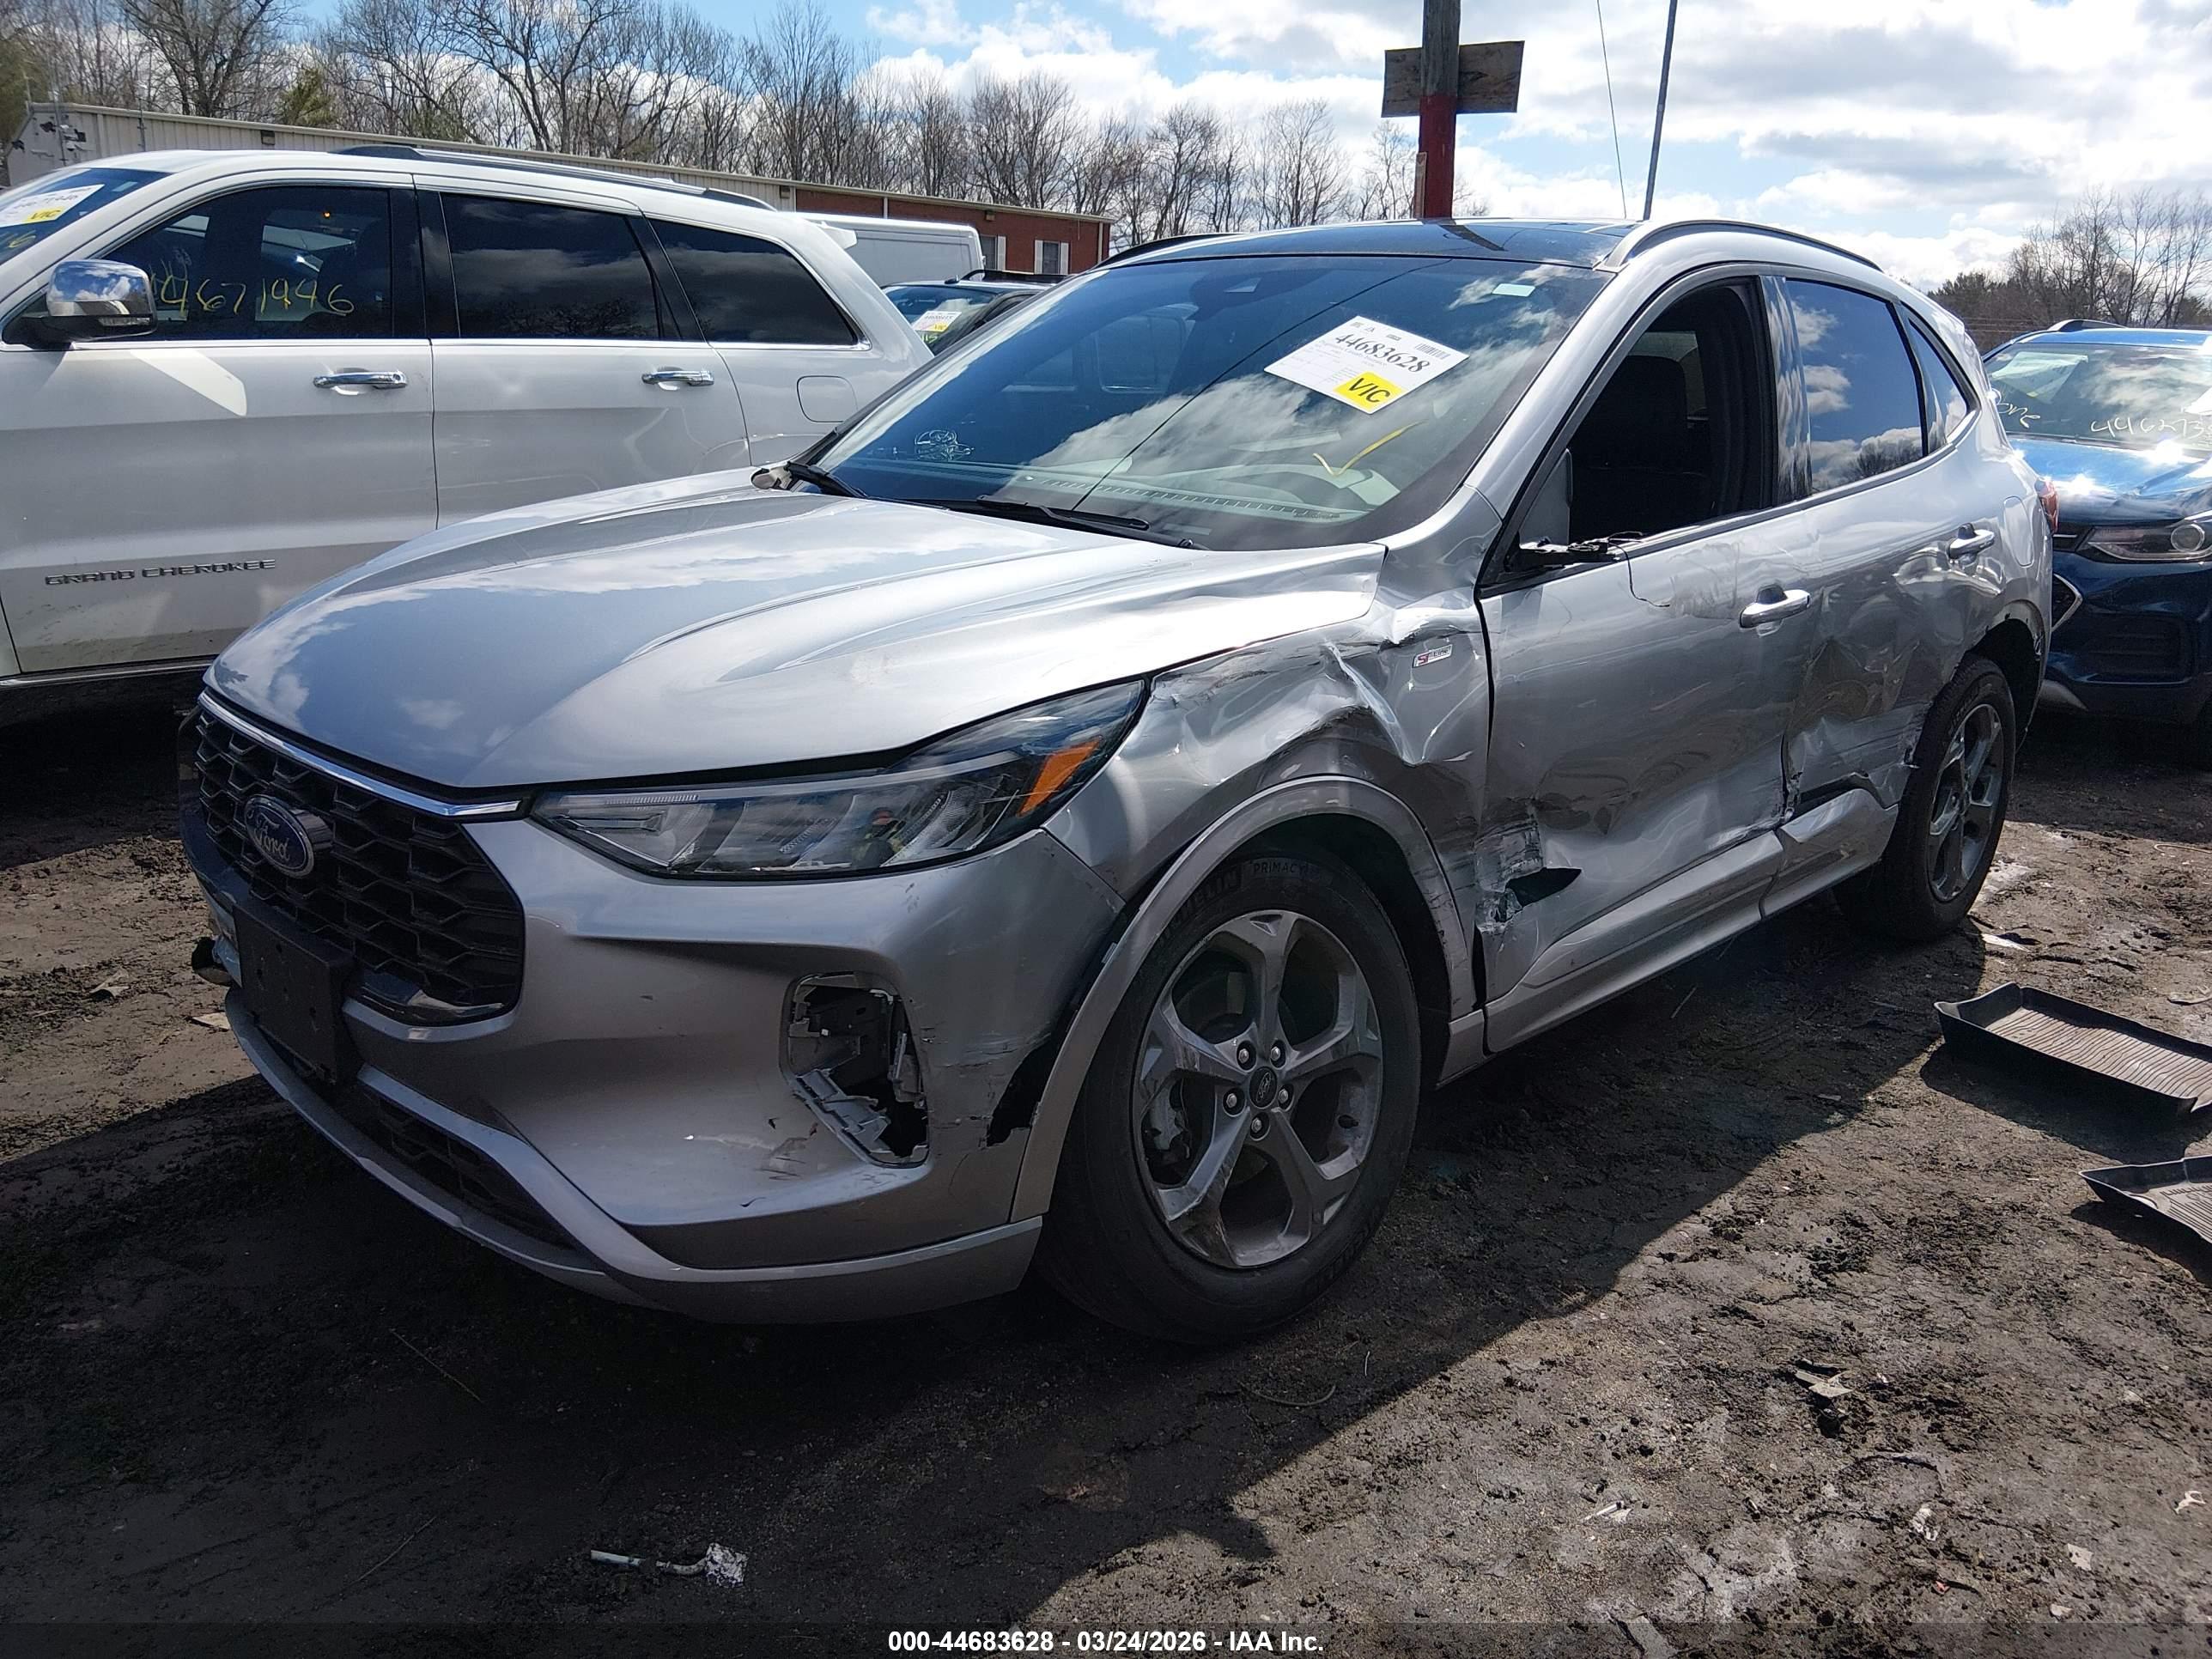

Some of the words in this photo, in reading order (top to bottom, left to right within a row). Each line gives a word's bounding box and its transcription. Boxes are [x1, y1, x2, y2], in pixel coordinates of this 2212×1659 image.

[1335, 333, 1431, 374] 44683628
[1348, 377, 1392, 404] VIC
[45, 569, 135, 586] GRAND
[142, 559, 276, 578] CHEROKEE
[1253, 861, 1309, 874] PRIMACY
